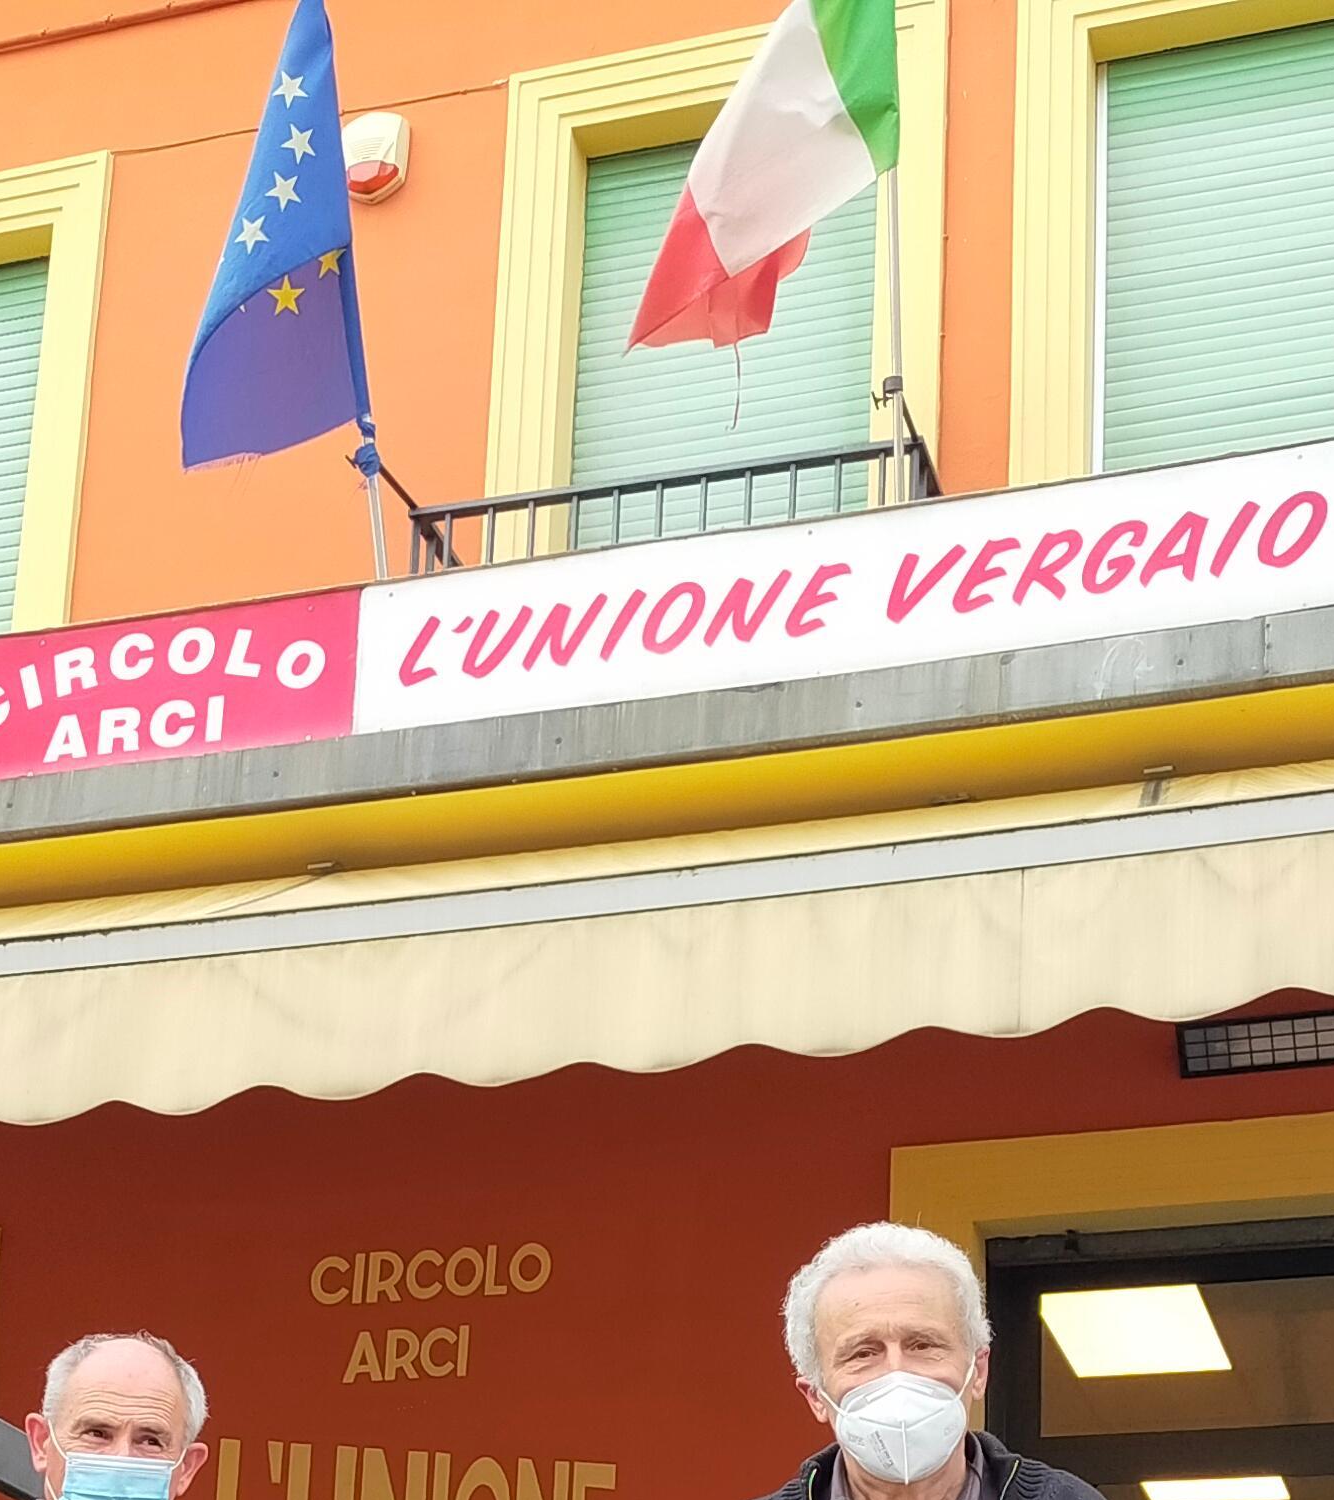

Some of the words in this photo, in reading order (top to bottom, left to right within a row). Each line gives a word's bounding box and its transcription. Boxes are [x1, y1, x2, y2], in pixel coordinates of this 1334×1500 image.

[397, 561, 852, 687] L'UNIONE
[886, 490, 1328, 624] VERGAIO
[43, 695, 226, 765] ARCI
[310, 1242, 552, 1304] CIRCOLO
[342, 1325, 470, 1384] ARCI
